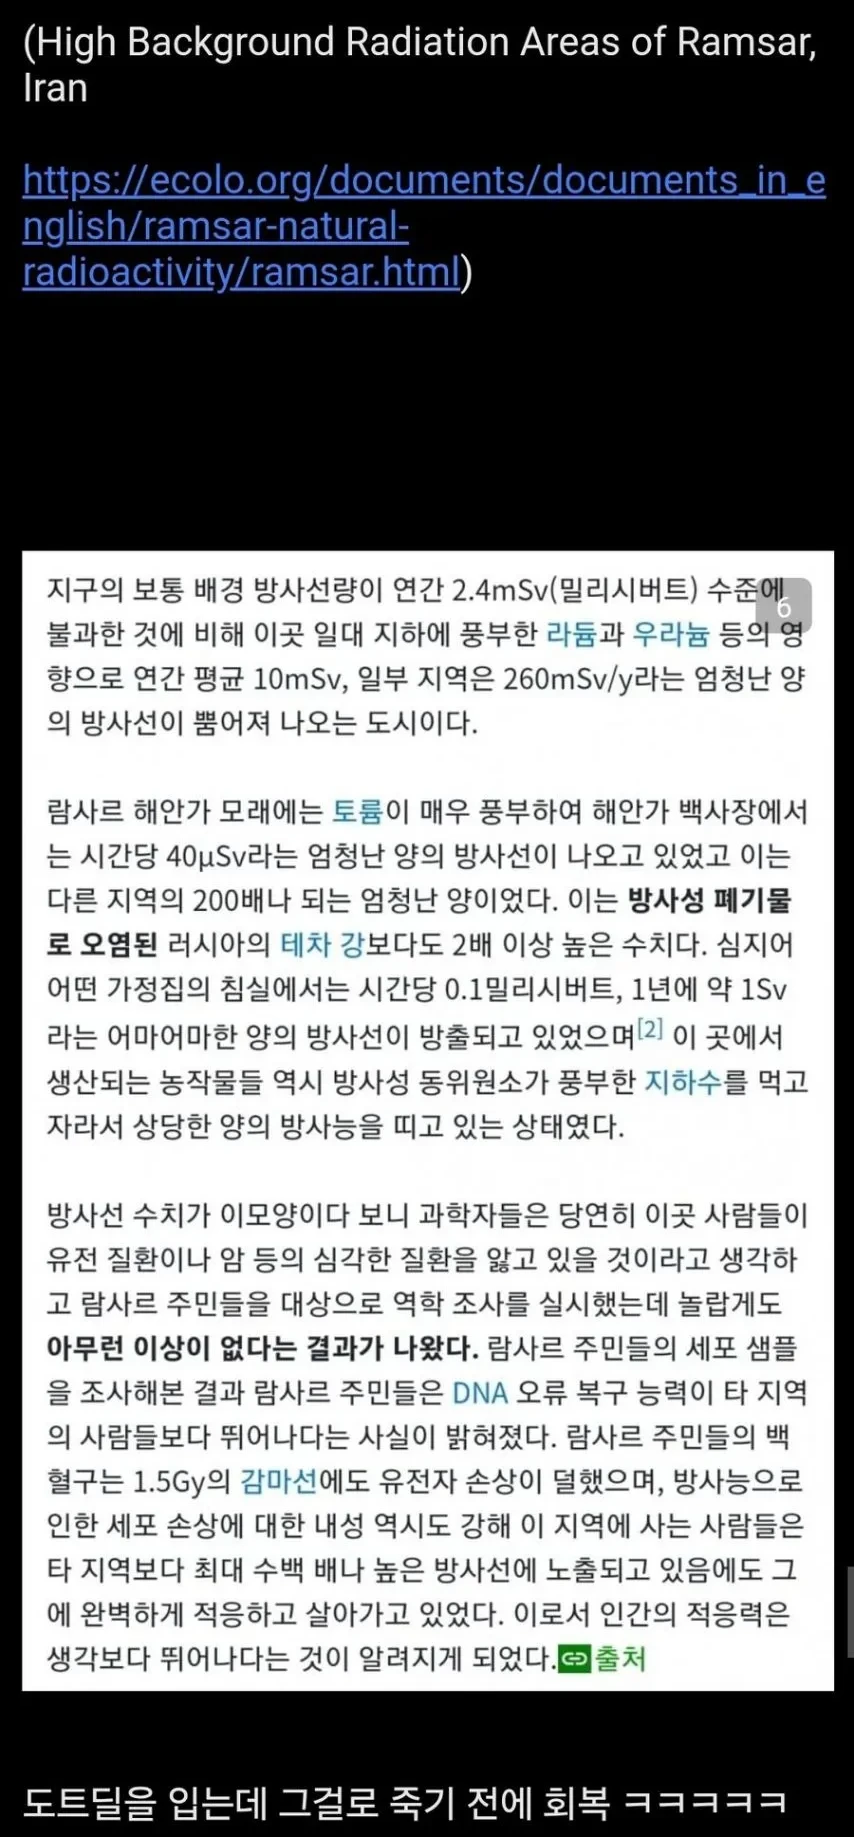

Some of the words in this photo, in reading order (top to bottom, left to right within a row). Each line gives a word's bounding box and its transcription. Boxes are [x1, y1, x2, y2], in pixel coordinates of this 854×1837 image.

[25, 24, 115, 64] (High
[130, 25, 333, 64] Background
[348, 25, 508, 55] Radiation
[520, 26, 619, 55] Areas
[632, 25, 667, 55] of
[679, 26, 815, 61] Ramsar,
[26, 73, 86, 102] Iran
[22, 164, 826, 201] https://ecolo.org/documents/documents_in_e
[22, 209, 409, 247] nglish/ramsar-natural-
[22, 253, 472, 294] radioactivity/ramsar.html)
[48, 711, 69, 736] 의
[82, 711, 182, 736] 방사선이
[194, 711, 269, 736] 뿜어져
[282, 711, 356, 736] 나오는
[367, 711, 476, 736] 도시이다.
[48, 1647, 150, 1672] 생각보다
[161, 1646, 289, 1671] 뛰어나다는
[301, 1647, 347, 1671] 것이
[360, 1647, 460, 1671] 알려지게
[473, 1647, 556, 1672] 되었다.
[594, 1646, 646, 1673] 출처
[24, 1786, 156, 1821] 도트딜을
[170, 1787, 266, 1820] 입는데
[279, 1787, 378, 1820] 그걸로
[390, 1787, 453, 1821] 죽기
[468, 1787, 531, 1820] 전에
[544, 1787, 610, 1821] 회복
[625, 1793, 785, 1813] ㅋㅋㅋㅋㅋ
